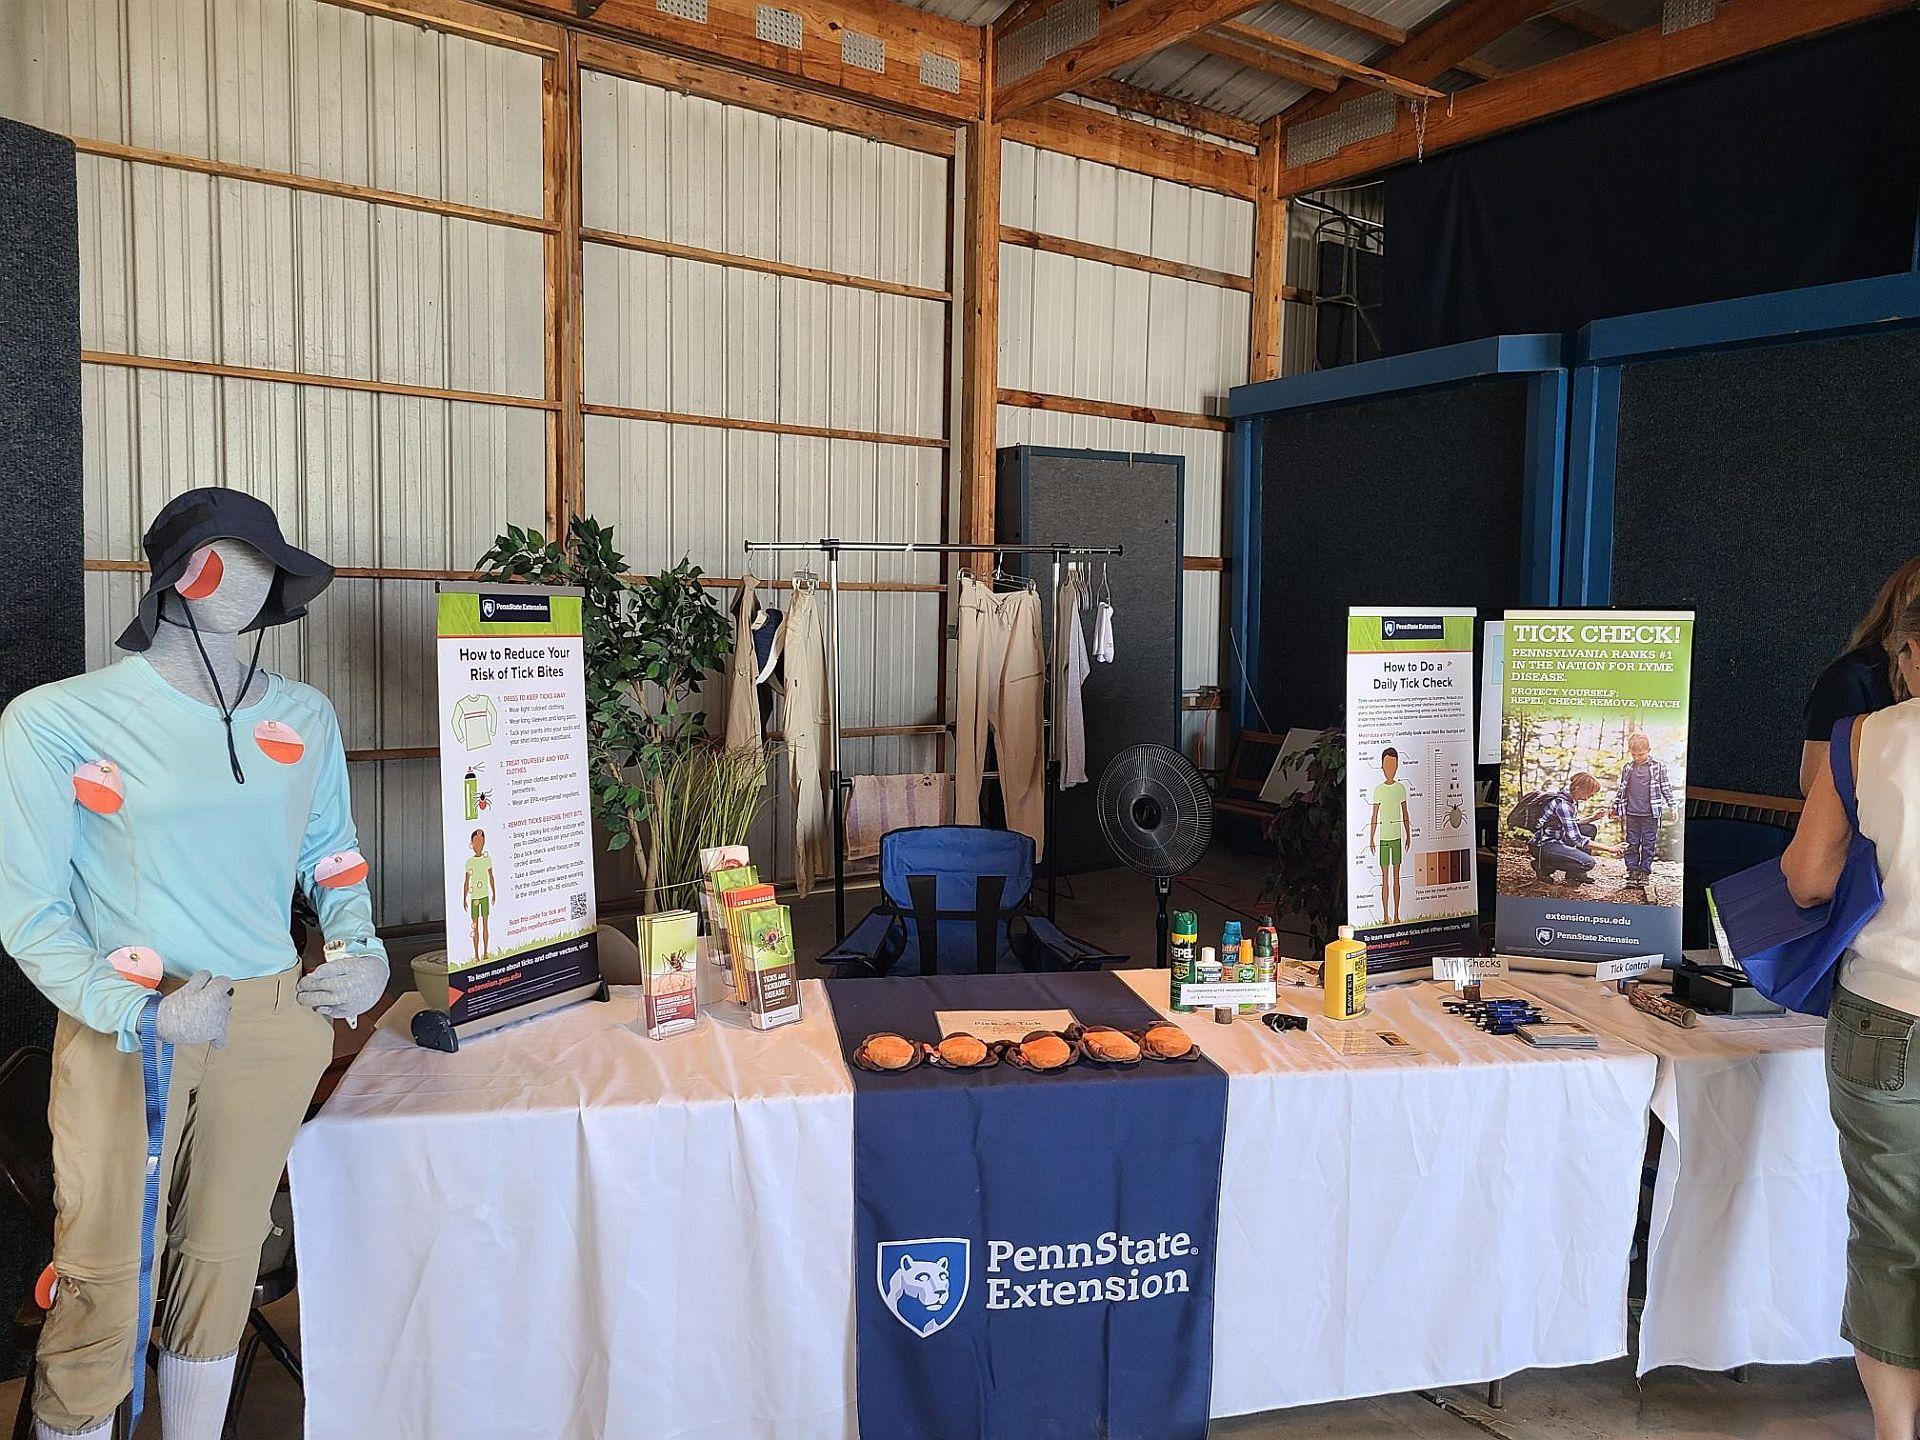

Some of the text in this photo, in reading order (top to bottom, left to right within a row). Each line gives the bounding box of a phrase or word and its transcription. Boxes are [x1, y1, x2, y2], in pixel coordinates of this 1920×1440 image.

[496, 603, 548, 611] PennState Extension
[1513, 625, 1681, 644] TICK CHECK!
[460, 647, 570, 661] How to Reduce Your
[1512, 649, 1673, 660] PENNSYLVANIA RANKS #1
[471, 665, 564, 680] Risk of Tick Bites
[1384, 661, 1443, 673] How to Do a
[1512, 661, 1673, 672] IN THE NATION FOR LYME
[1511, 672, 1567, 682] DISEASE.
[1373, 677, 1453, 691] Daily Tick Check
[1511, 688, 1619, 697] PROTECT YOURSELF:
[1510, 697, 1680, 709] REPEL, CHECK, REMOVE, WATCH
[521, 756, 545, 765] YOURSELF
[508, 820, 527, 828] REMOVE
[528, 817, 542, 825] TICKS
[543, 814, 561, 822] BEFORE
[562, 811, 573, 819] THEY
[1545, 912, 1631, 925] extension.psu.edu
[1557, 931, 1639, 945] PennState Extension
[467, 942, 588, 983] To learn more about ticks and other vectors, visit
[1466, 958, 1501, 968] Checks
[1611, 960, 1650, 973] Tick Control
[467, 972, 522, 994] extension.psu.edu
[763, 973, 777, 983] TICKS
[764, 979, 791, 991] TICKBORNE
[764, 988, 785, 999] DISEASE
[987, 1232, 1190, 1272] PennState
[986, 1267, 1189, 1310] Extension
